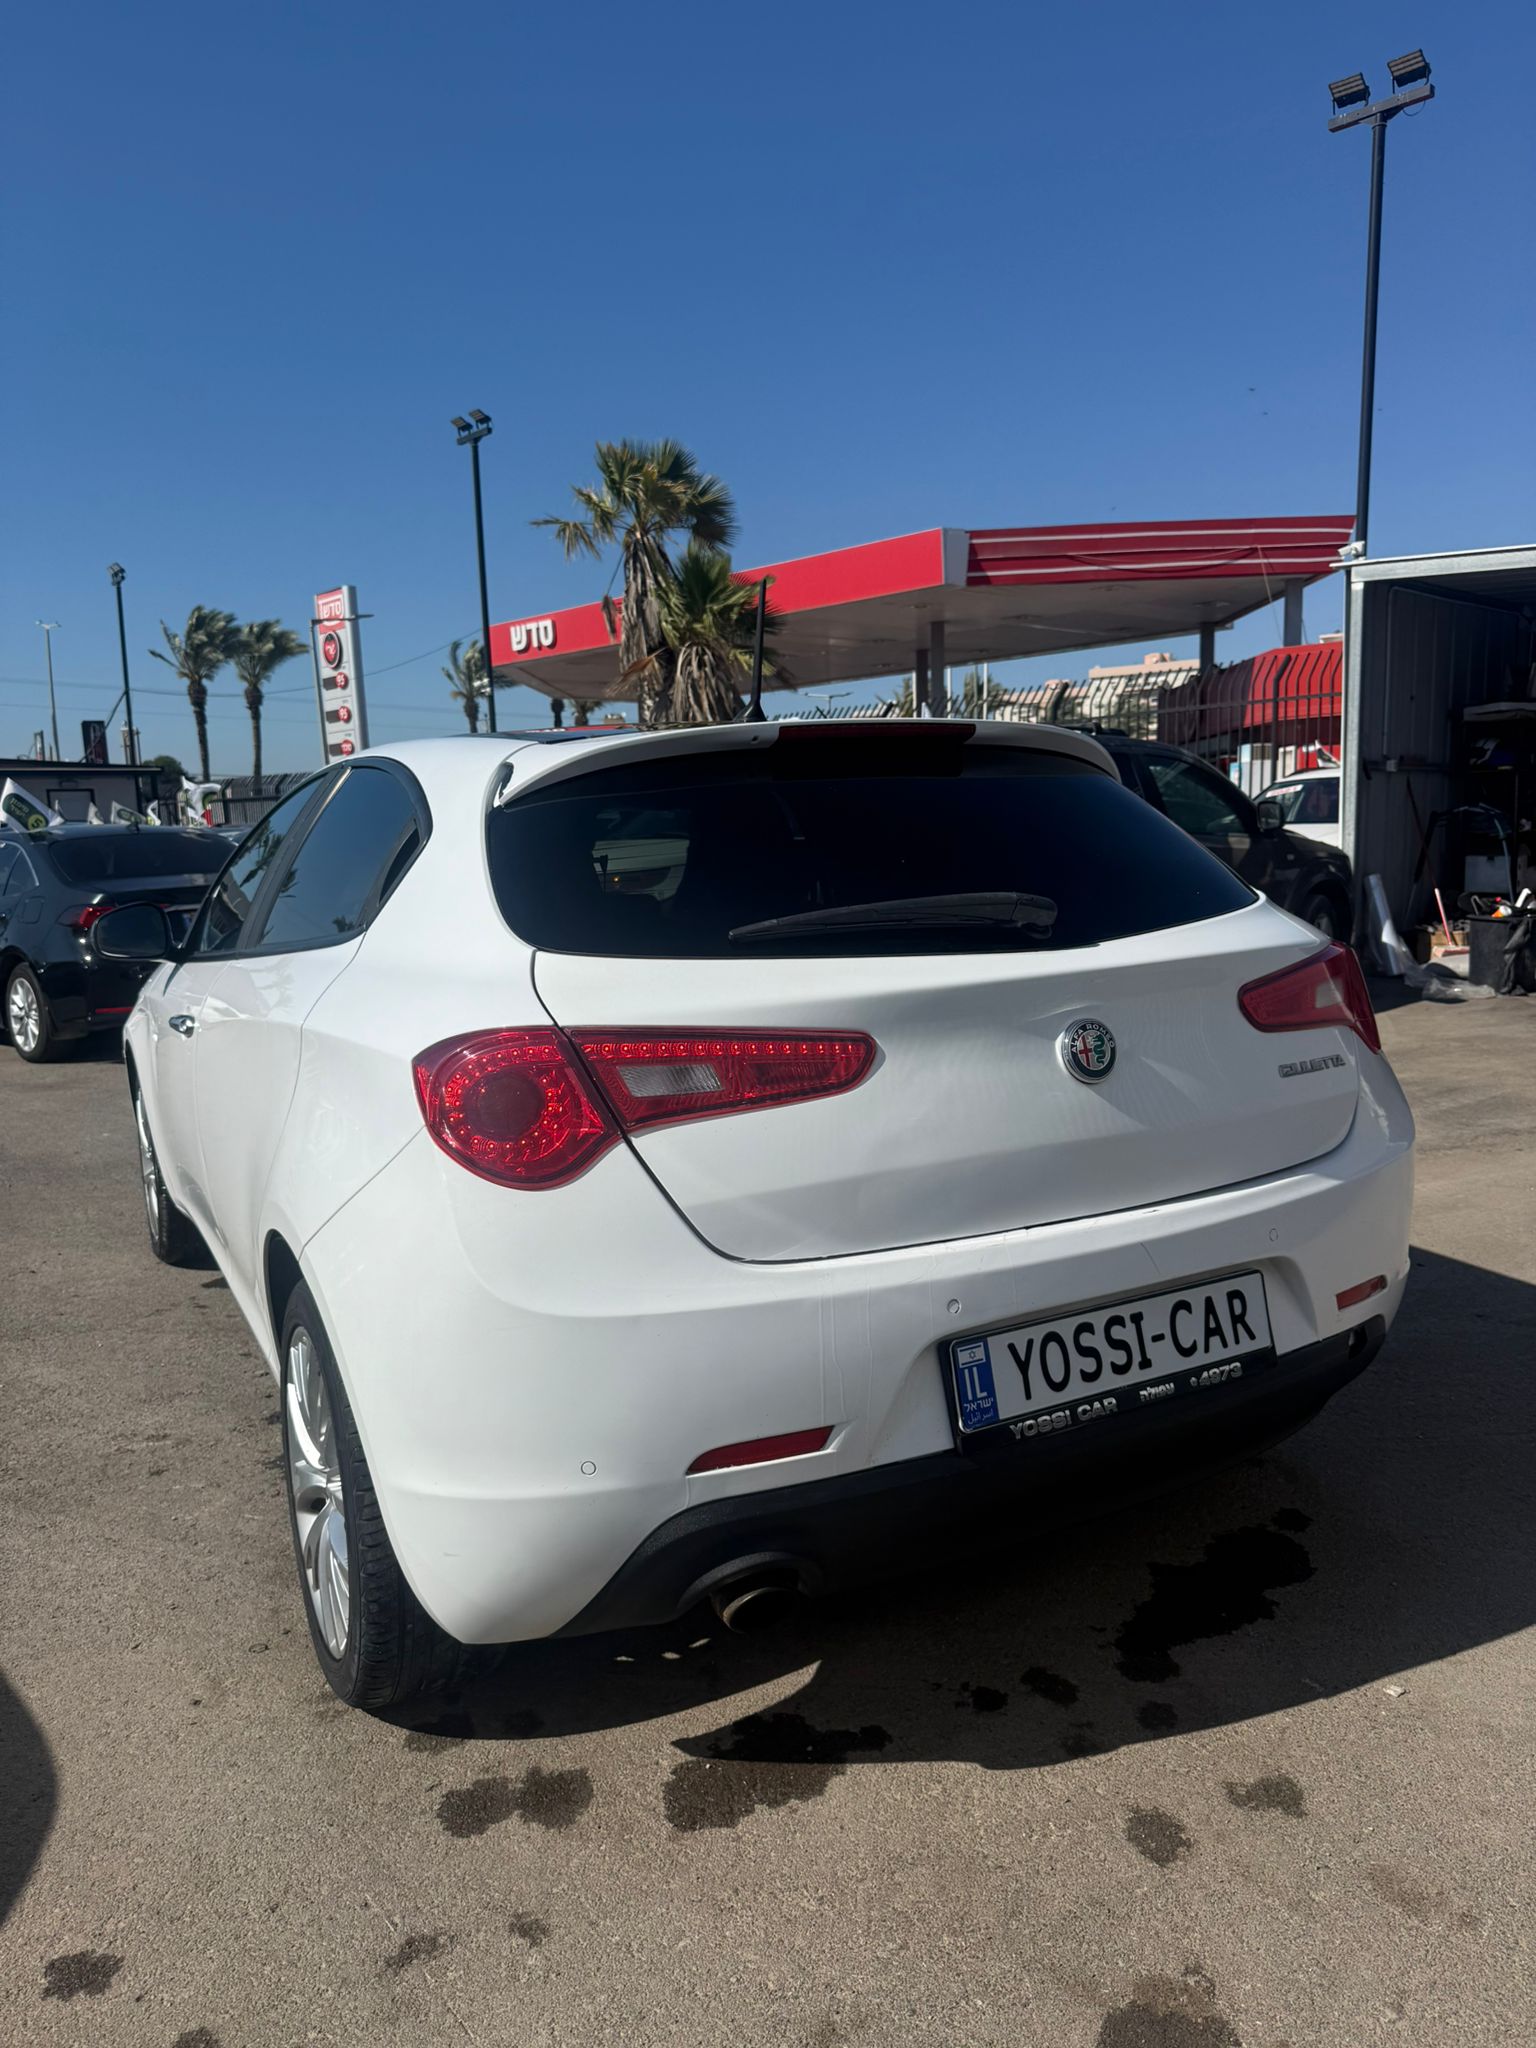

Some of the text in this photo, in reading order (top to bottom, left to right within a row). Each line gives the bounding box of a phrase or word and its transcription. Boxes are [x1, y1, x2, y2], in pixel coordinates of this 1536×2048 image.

[510, 618, 554, 652] סדש
[1071, 1023, 1115, 1053] ALFA ROMEO
[1007, 1289, 1257, 1401] YOSSI-CAR
[963, 1366, 988, 1401] IL
[1139, 1382, 1176, 1402] עפולה
[963, 1397, 994, 1412] ישראל
[1009, 1396, 1119, 1439] YOSSI CAR
